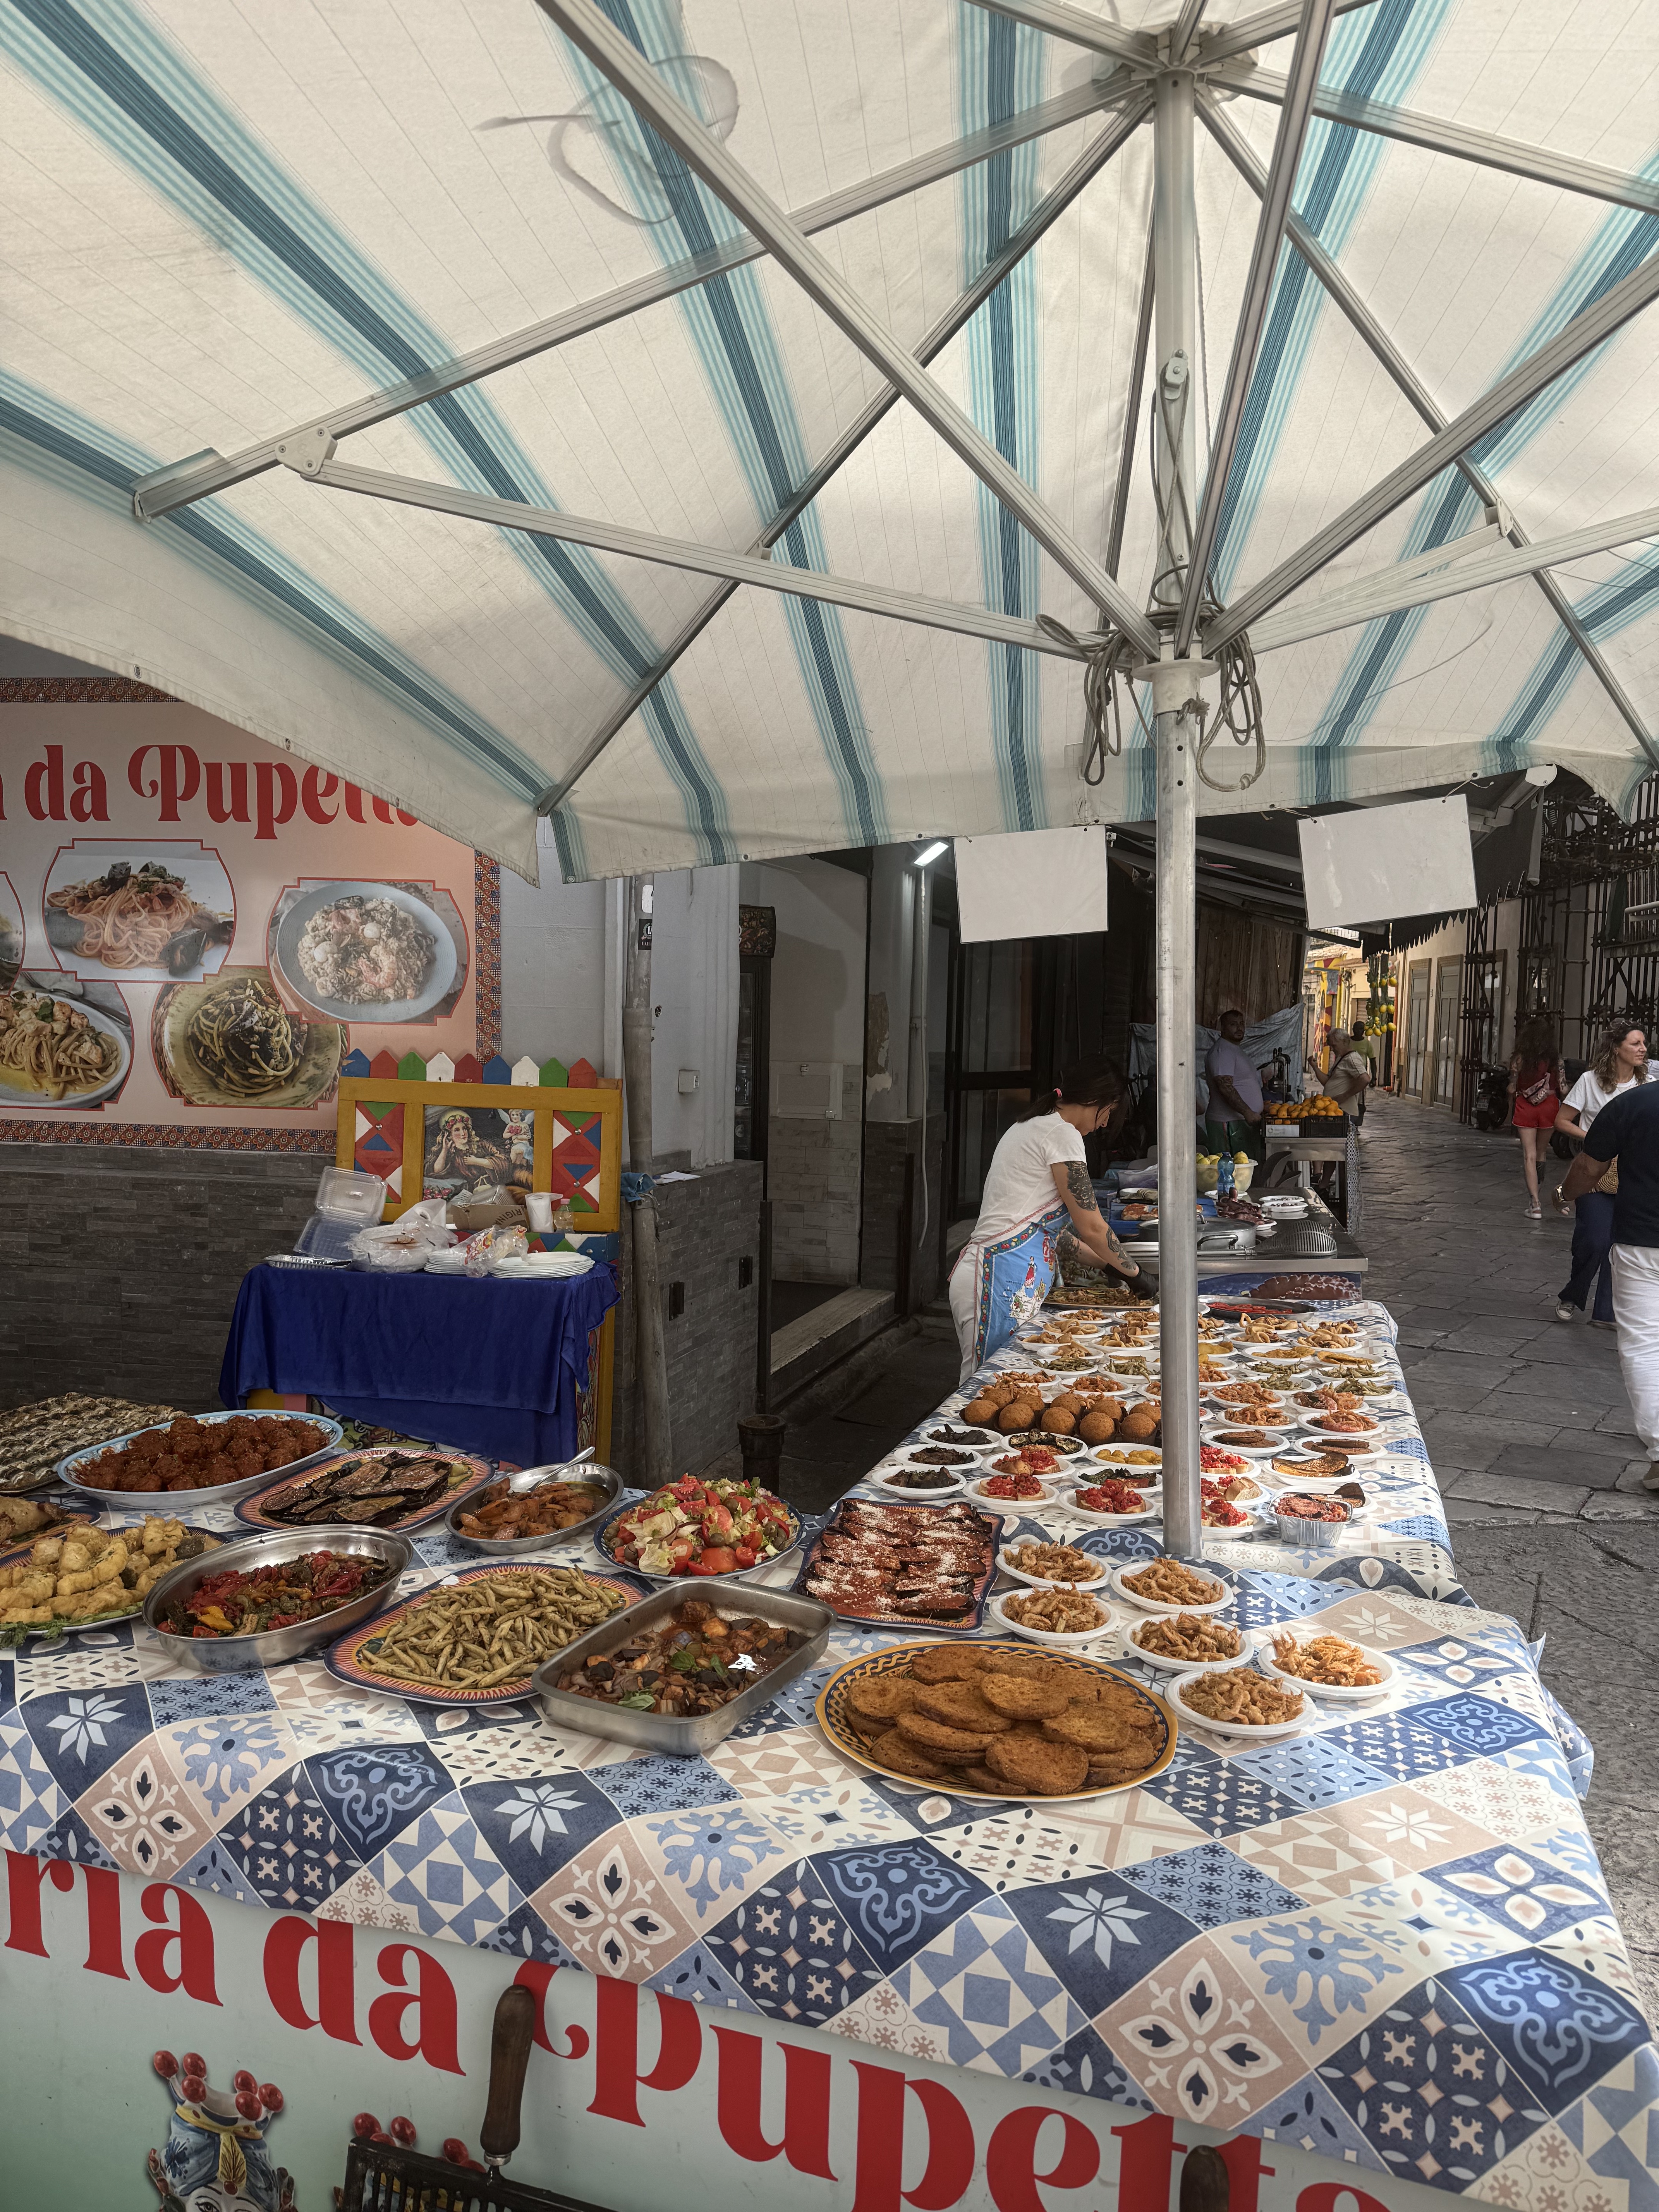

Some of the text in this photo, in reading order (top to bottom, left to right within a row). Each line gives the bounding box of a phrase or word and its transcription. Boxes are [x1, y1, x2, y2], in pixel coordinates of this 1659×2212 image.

[24, 744, 111, 823] da
[127, 744, 418, 840] Pupe
[263, 1915, 466, 2076] da
[513, 1959, 1390, 2212] Pupet
